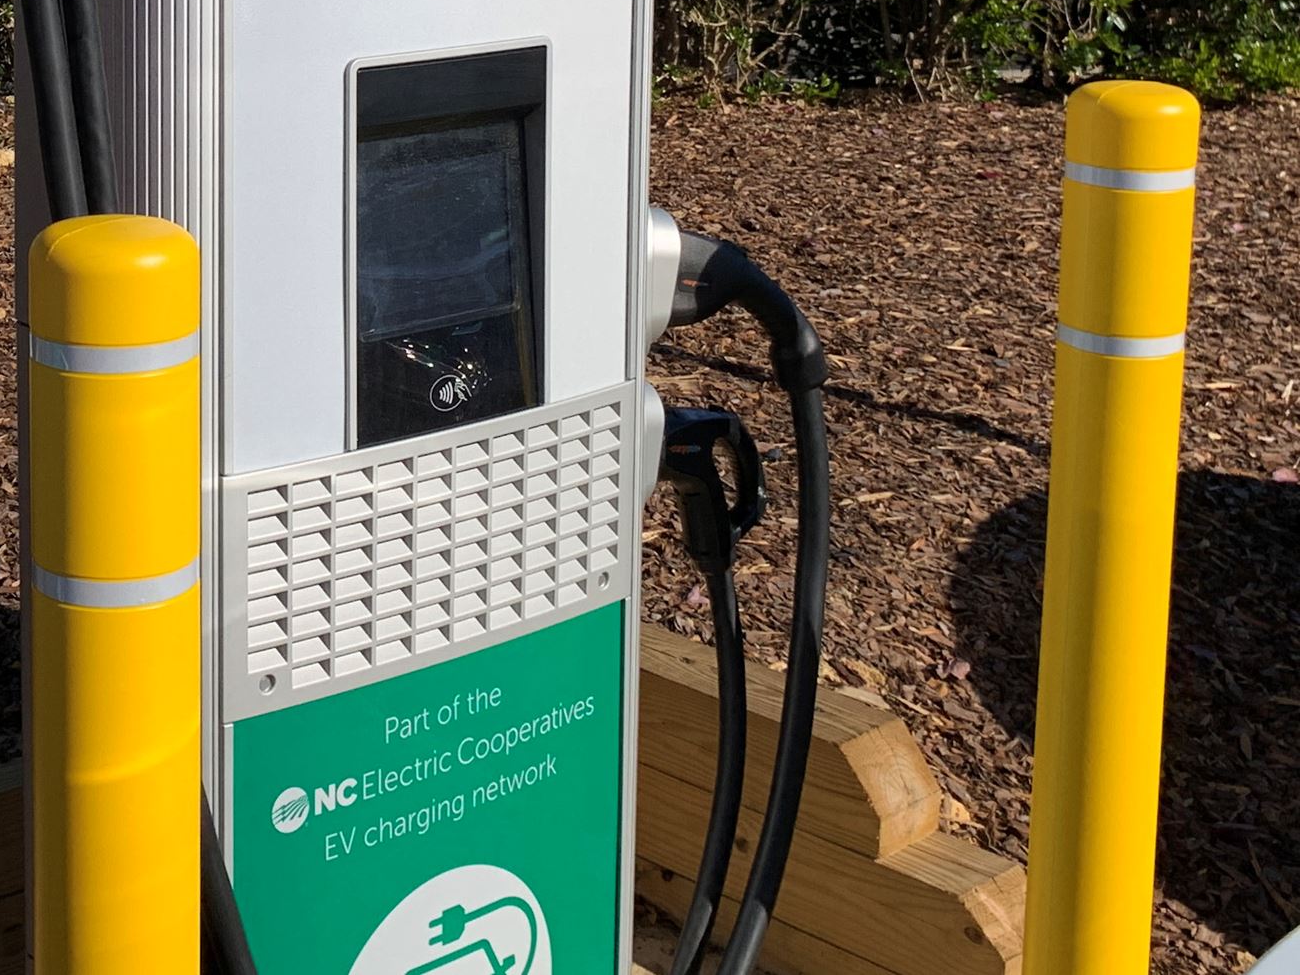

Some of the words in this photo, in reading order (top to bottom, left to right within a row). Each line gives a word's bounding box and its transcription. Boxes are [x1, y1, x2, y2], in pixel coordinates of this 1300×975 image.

[314, 777, 358, 816] NC
[362, 750, 451, 800] Electric
[457, 696, 595, 765] Cooperatives
[385, 707, 430, 744] Part
[437, 693, 460, 726] of
[467, 687, 502, 715] the
[325, 827, 356, 861] EV
[364, 794, 465, 847] charging
[472, 753, 557, 808] network
